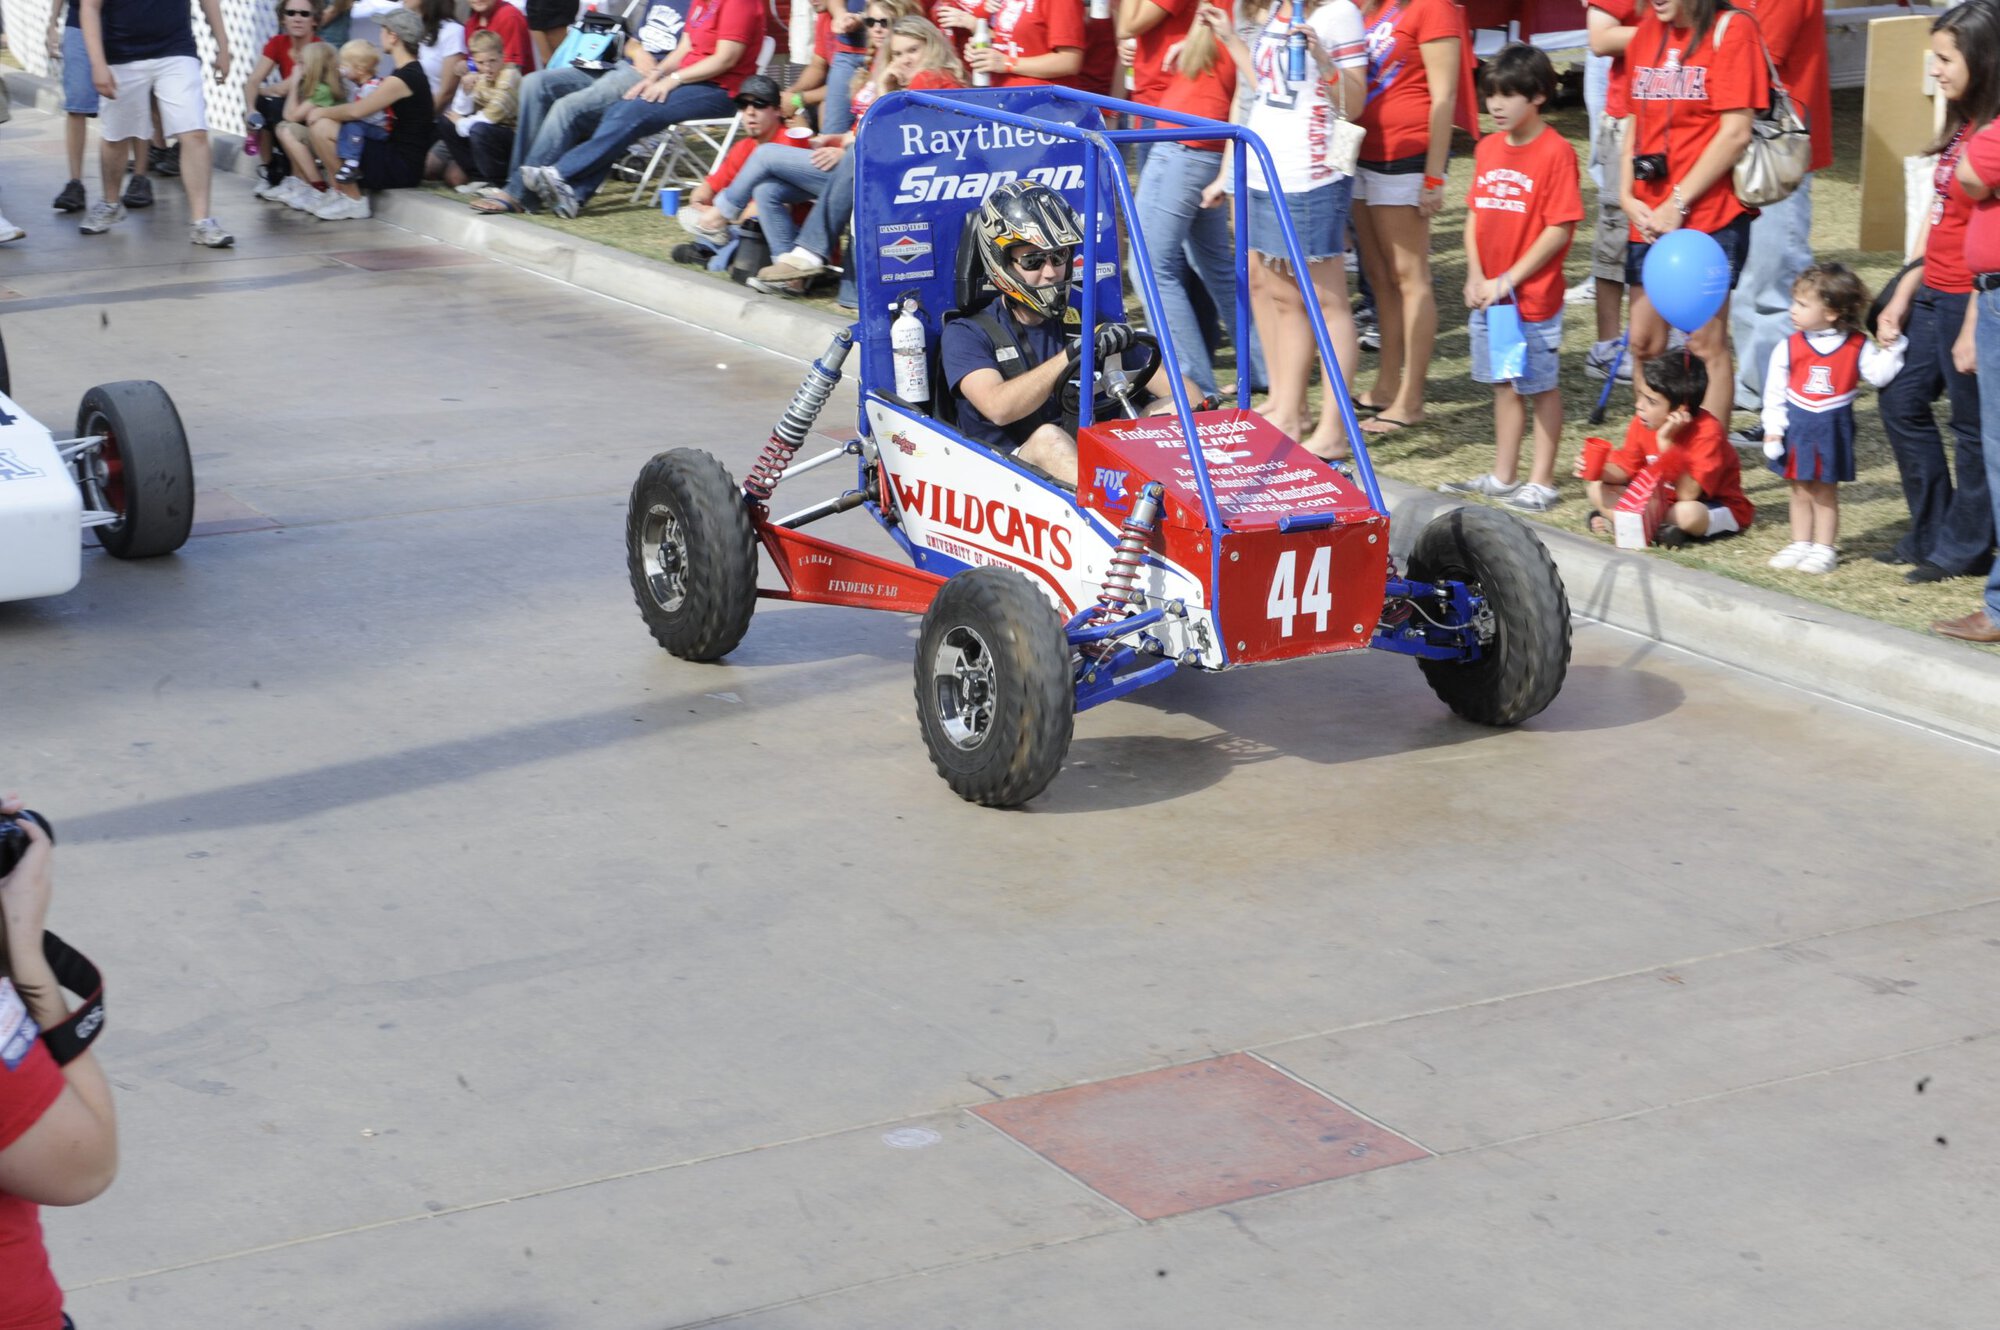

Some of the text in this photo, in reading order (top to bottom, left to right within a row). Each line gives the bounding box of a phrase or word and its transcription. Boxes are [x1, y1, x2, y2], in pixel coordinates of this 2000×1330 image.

[1802, 365, 1835, 395] A
[1109, 419, 1256, 441] Finders Frication
[1155, 433, 1248, 448] RELINE
[1093, 466, 1129, 490] FOX
[1232, 459, 1288, 474] Electric
[1265, 480, 1343, 501] Manufacturing
[890, 472, 1073, 571] WILDCATS
[925, 534, 971, 561] UNIVERSITY
[974, 551, 983, 566] OF
[828, 579, 898, 597] FINDERS FAB
[1267, 546, 1332, 637] 44
